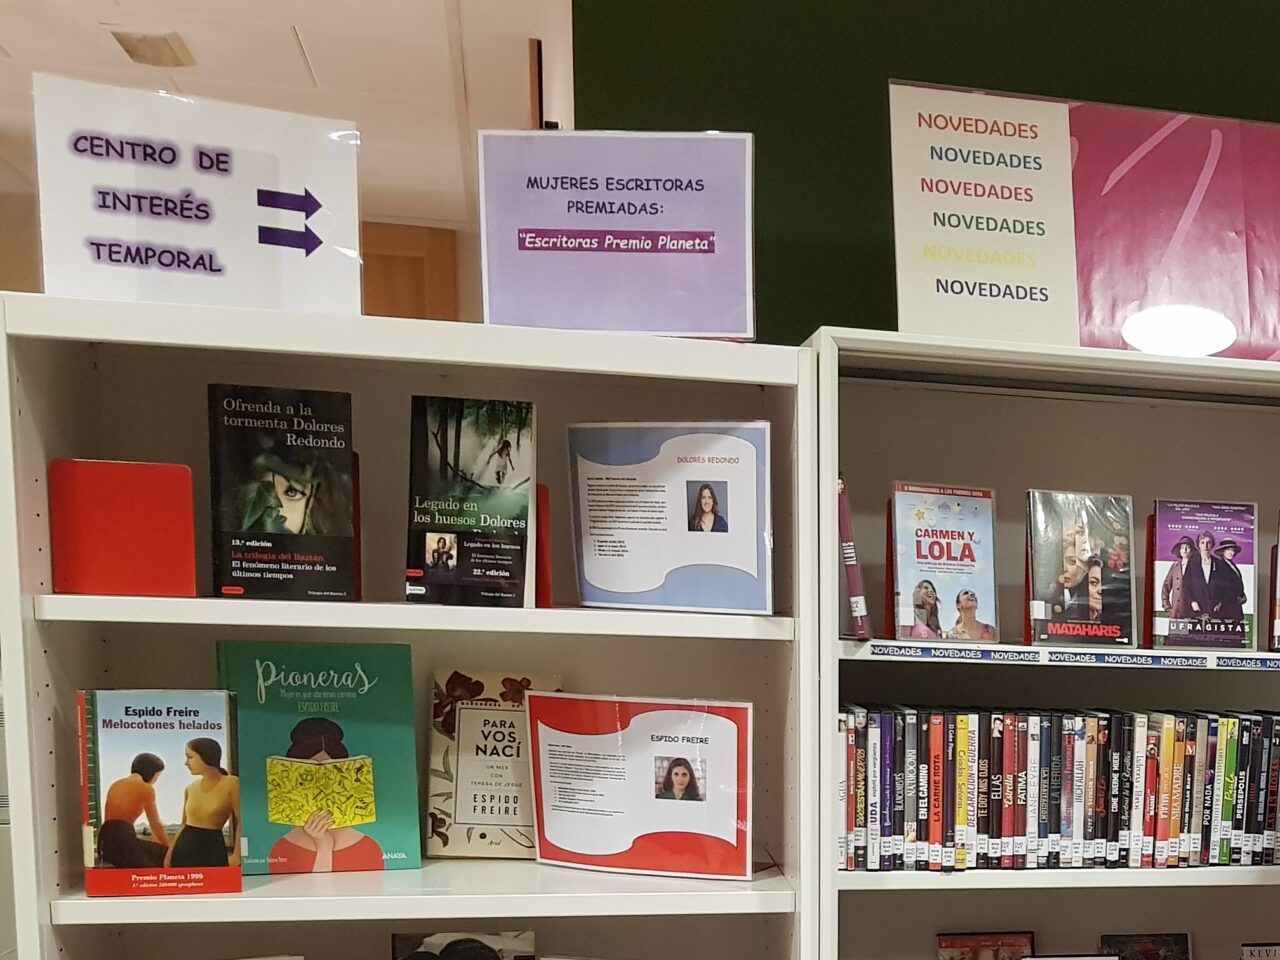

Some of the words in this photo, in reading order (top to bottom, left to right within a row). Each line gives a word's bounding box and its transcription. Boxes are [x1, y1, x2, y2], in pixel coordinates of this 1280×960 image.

[917, 113, 1038, 140] NOVEDADES
[72, 135, 177, 166] CENTRO
[199, 149, 231, 172] DE
[929, 146, 1042, 170] NOVEDADES
[526, 176, 598, 192] MUJERES
[605, 177, 704, 192] ESCRITORAS
[921, 178, 1034, 202] NOVEDADES
[97, 189, 211, 221] INTERÉS
[567, 201, 664, 216] PREMIADAS:
[933, 212, 1046, 236] NOVEDADES
[605, 234, 651, 250] Premio
[89, 241, 222, 274] TEMPORAL
[923, 244, 1037, 267] NOVEDADES
[935, 279, 1048, 302] NOVEDADES
[223, 398, 281, 414] Ofrenda
[286, 406, 293, 414] a
[299, 403, 312, 415] la
[224, 415, 288, 429] tormenta
[293, 418, 344, 433] Dolores
[286, 433, 345, 448] Redondo
[415, 497, 459, 511] Legado
[464, 502, 477, 511] en
[414, 513, 431, 523] los
[435, 515, 475, 525] huesos
[480, 514, 525, 528] Dolores
[916, 528, 965, 540] CARMEN
[968, 532, 975, 540] Y
[916, 540, 975, 562] LOLA
[1048, 623, 1120, 637] MATAHARIS
[932, 649, 982, 658] NOVEDADES
[1049, 653, 1096, 662] NOVEDADES
[255, 659, 378, 703] Pioneras
[125, 706, 162, 717] Espido
[166, 707, 199, 717] Freire
[102, 720, 175, 730] Melocotones
[179, 720, 222, 730] helados
[483, 720, 515, 728] PARA
[481, 731, 515, 743] VOS
[651, 735, 679, 743] ESPIDO
[681, 736, 709, 744] FREIRE
[475, 740, 520, 758] NACÍ
[992, 774, 1002, 799] ELLAS
[1018, 771, 1027, 804] FATIMA
[1236, 770, 1246, 819] PERSEPOLIS
[473, 794, 519, 804] ESPIDO
[473, 805, 518, 816] FREIRE
